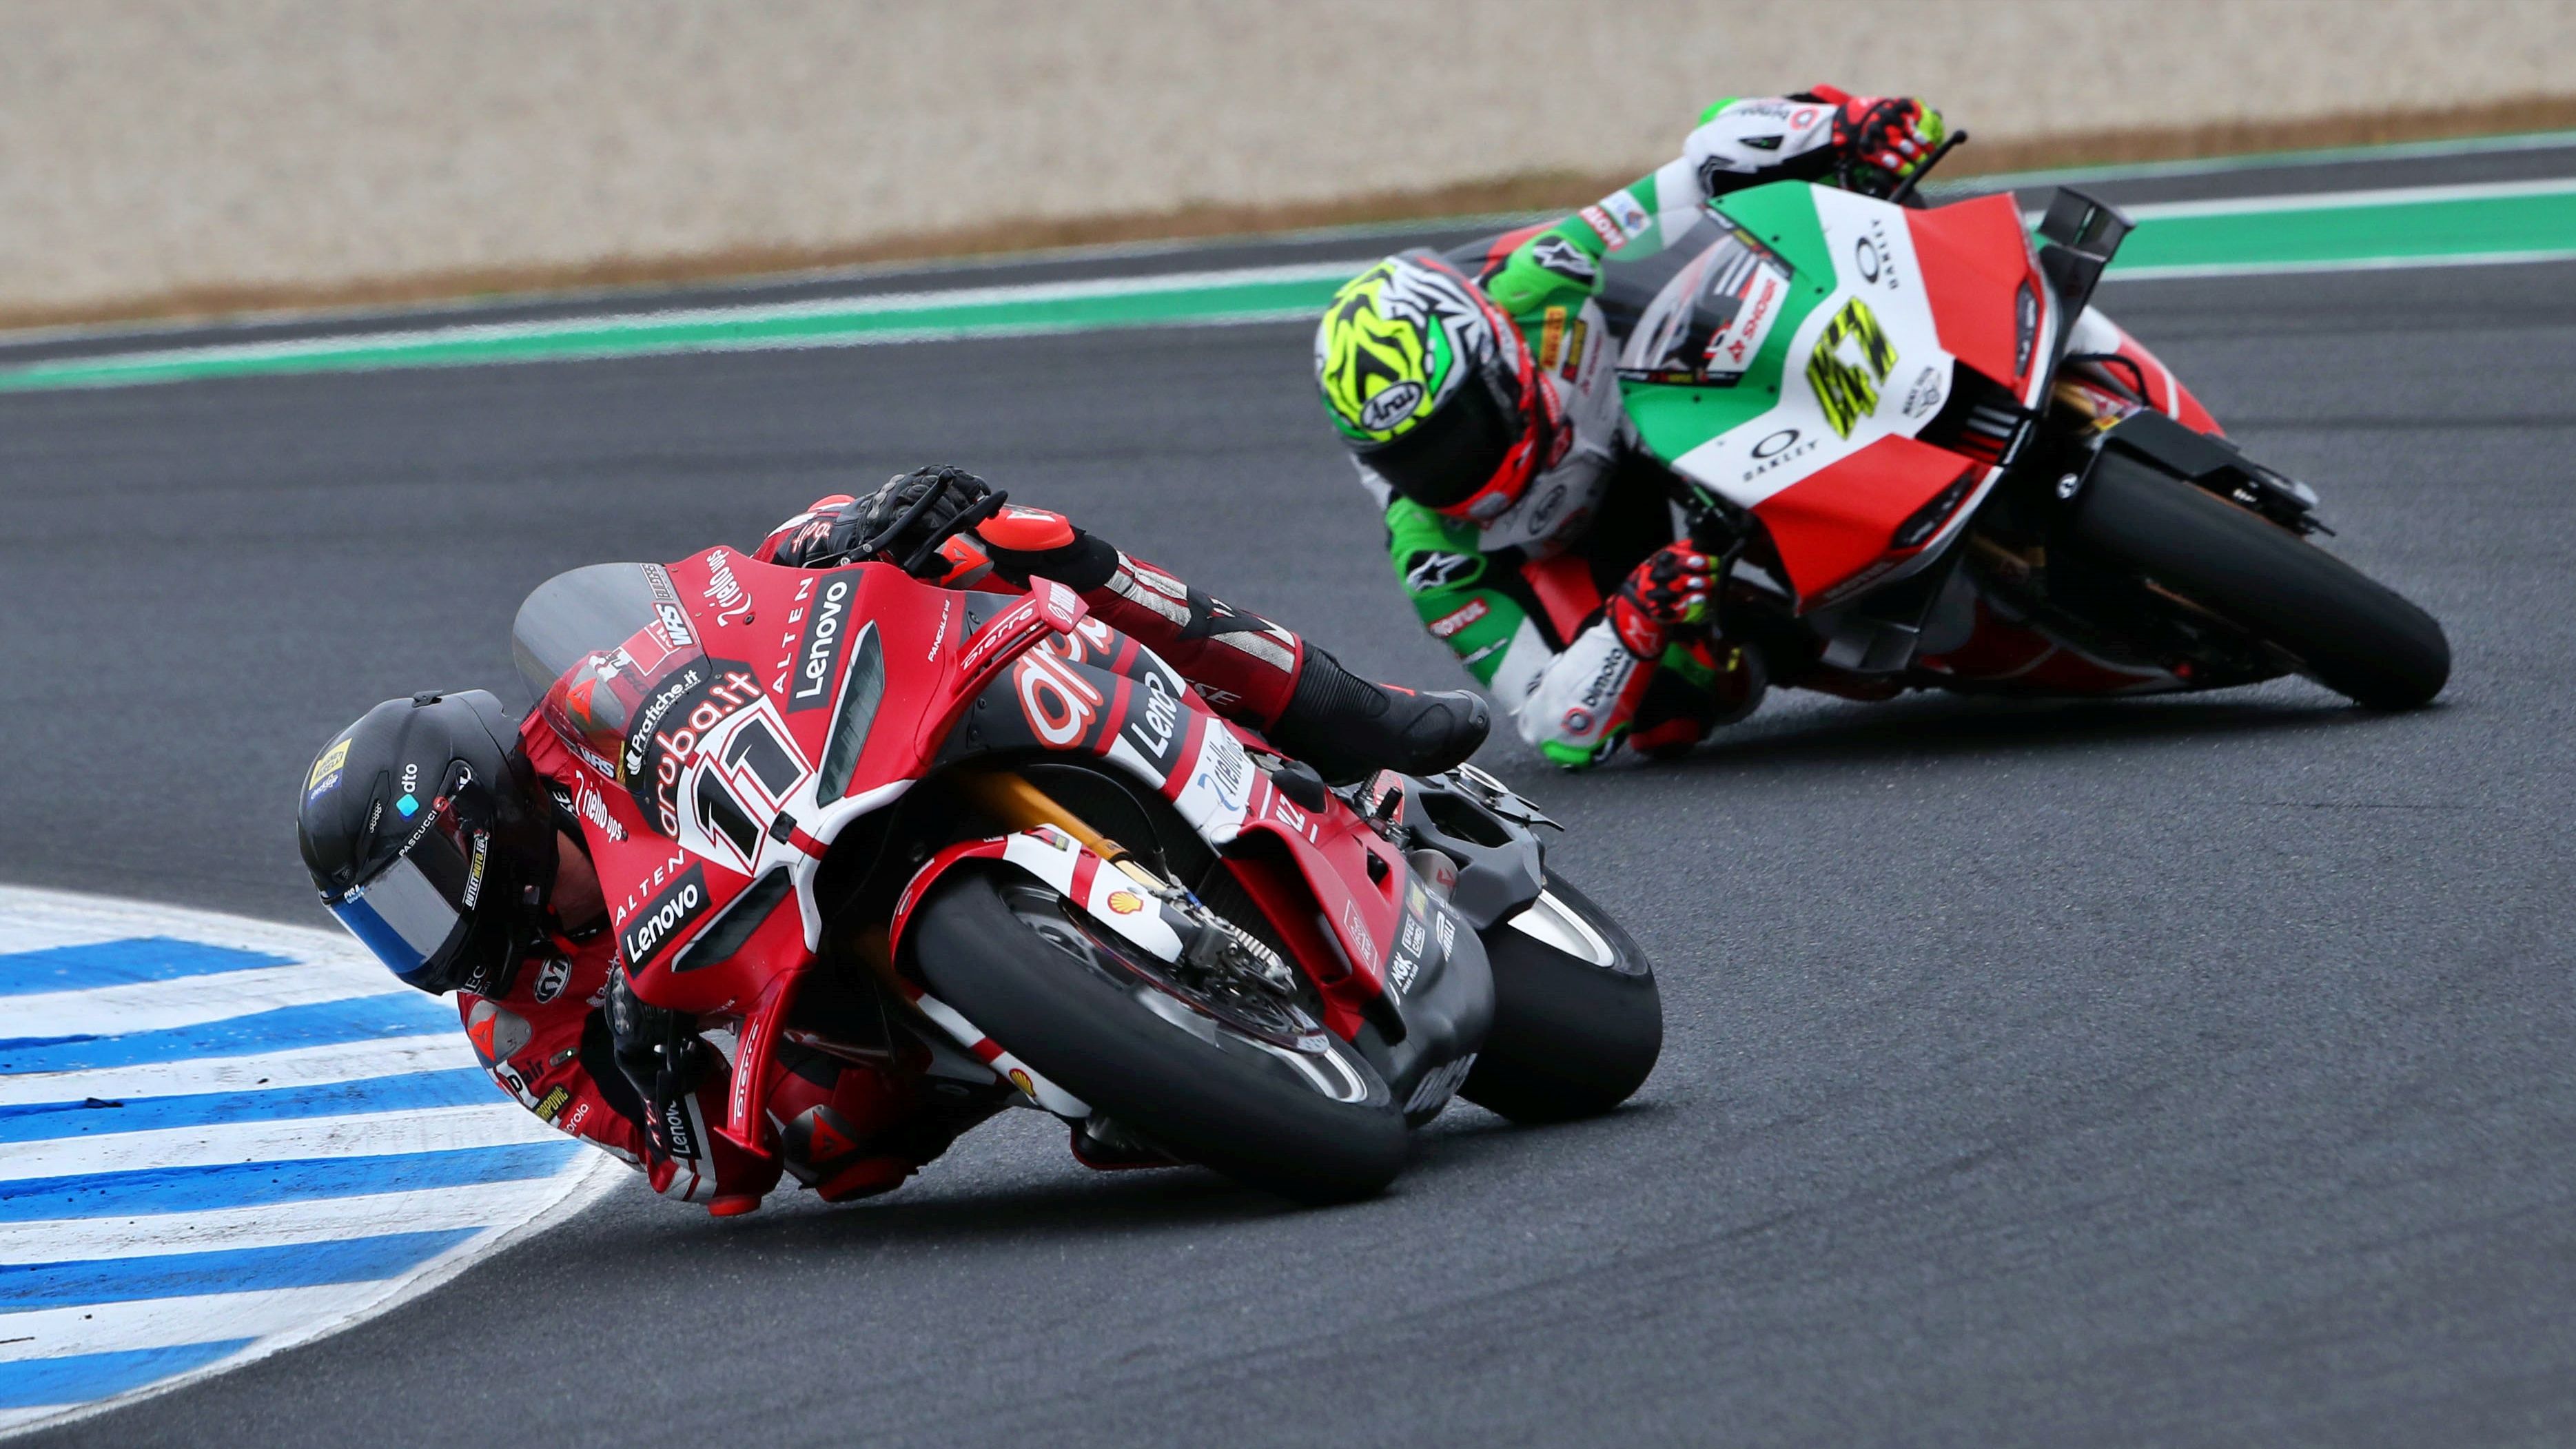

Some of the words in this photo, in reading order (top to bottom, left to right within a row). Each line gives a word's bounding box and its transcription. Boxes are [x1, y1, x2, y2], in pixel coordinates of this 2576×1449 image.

[1870, 218, 1900, 291] OAKLEY
[1742, 440, 1820, 483] OAKLEY
[655, 604, 693, 646] WRS
[772, 577, 815, 695] ALTEN
[795, 580, 848, 699] Lenovo
[927, 613, 949, 663] PANIGALE
[1582, 647, 1626, 707] bimota
[631, 669, 698, 753] Pratiche.it
[400, 763, 419, 793] dto
[580, 746, 616, 779] WRS
[654, 669, 762, 839] aruba.it
[693, 706, 809, 872] 11
[398, 809, 438, 858] PASCUCCI
[615, 848, 686, 927] ALTEN
[625, 883, 699, 965] Lenovo
[1391, 951, 1413, 988] NGK
[565, 1102, 589, 1133] orola
